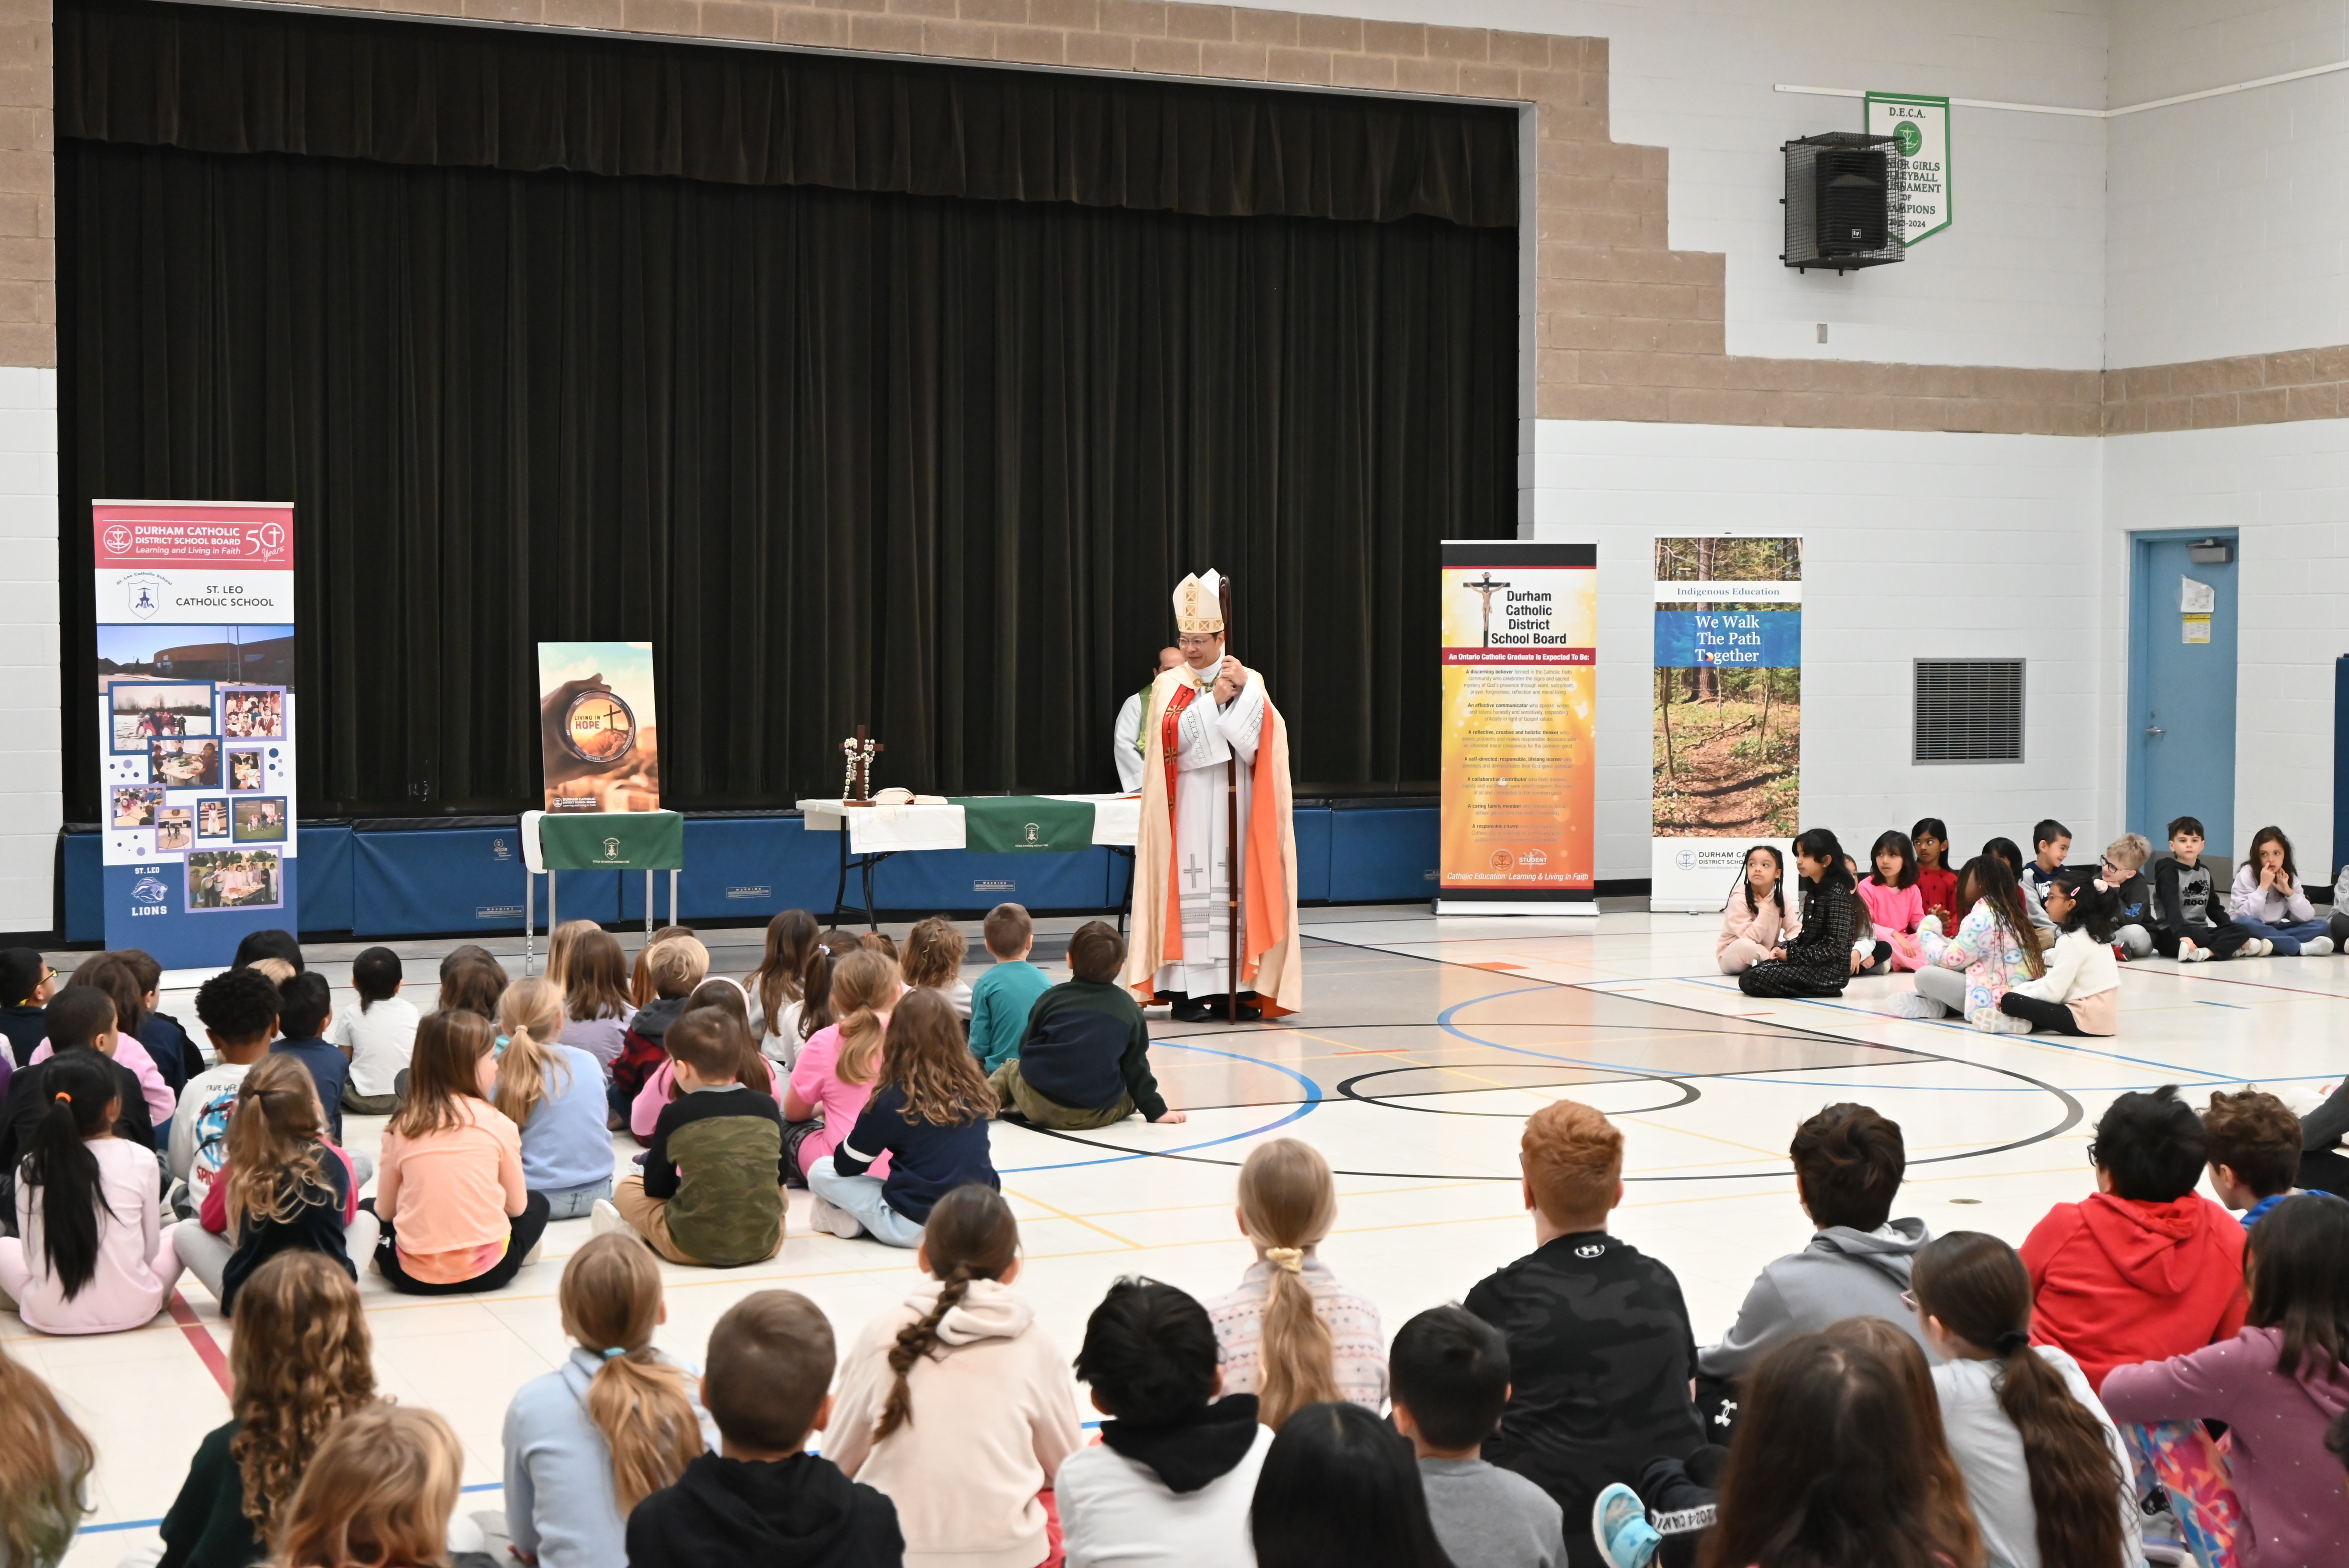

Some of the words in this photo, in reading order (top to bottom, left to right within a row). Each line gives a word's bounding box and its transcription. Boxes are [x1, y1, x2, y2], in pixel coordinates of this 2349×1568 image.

[1889, 107, 1926, 118] D.E.C.A.
[1912, 161, 1940, 171] GIRLS
[135, 526, 184, 535] DURHAM
[187, 527, 240, 536] CATHOLIC
[136, 546, 169, 555] Learning
[188, 547, 210, 556] Living
[262, 546, 285, 562] Years
[157, 574, 172, 585] School
[1507, 590, 1551, 601] Durham
[1677, 588, 1730, 597] Indigenous
[176, 598, 227, 606] CATHOLIC
[231, 598, 274, 606] SCHOOL
[1506, 605, 1552, 616] Catholic
[1509, 619, 1550, 630] District
[1695, 615, 1718, 628] We
[1722, 615, 1760, 628] Walk
[1491, 633, 1529, 644] School
[1533, 633, 1567, 644] Board
[1697, 632, 1724, 645] The
[1729, 632, 1761, 645] Path
[1695, 648, 1759, 664] Together
[576, 721, 600, 729] HOPE
[1509, 873, 1536, 882] Learning
[1545, 873, 1563, 882] Living
[132, 906, 167, 916] LIONS
